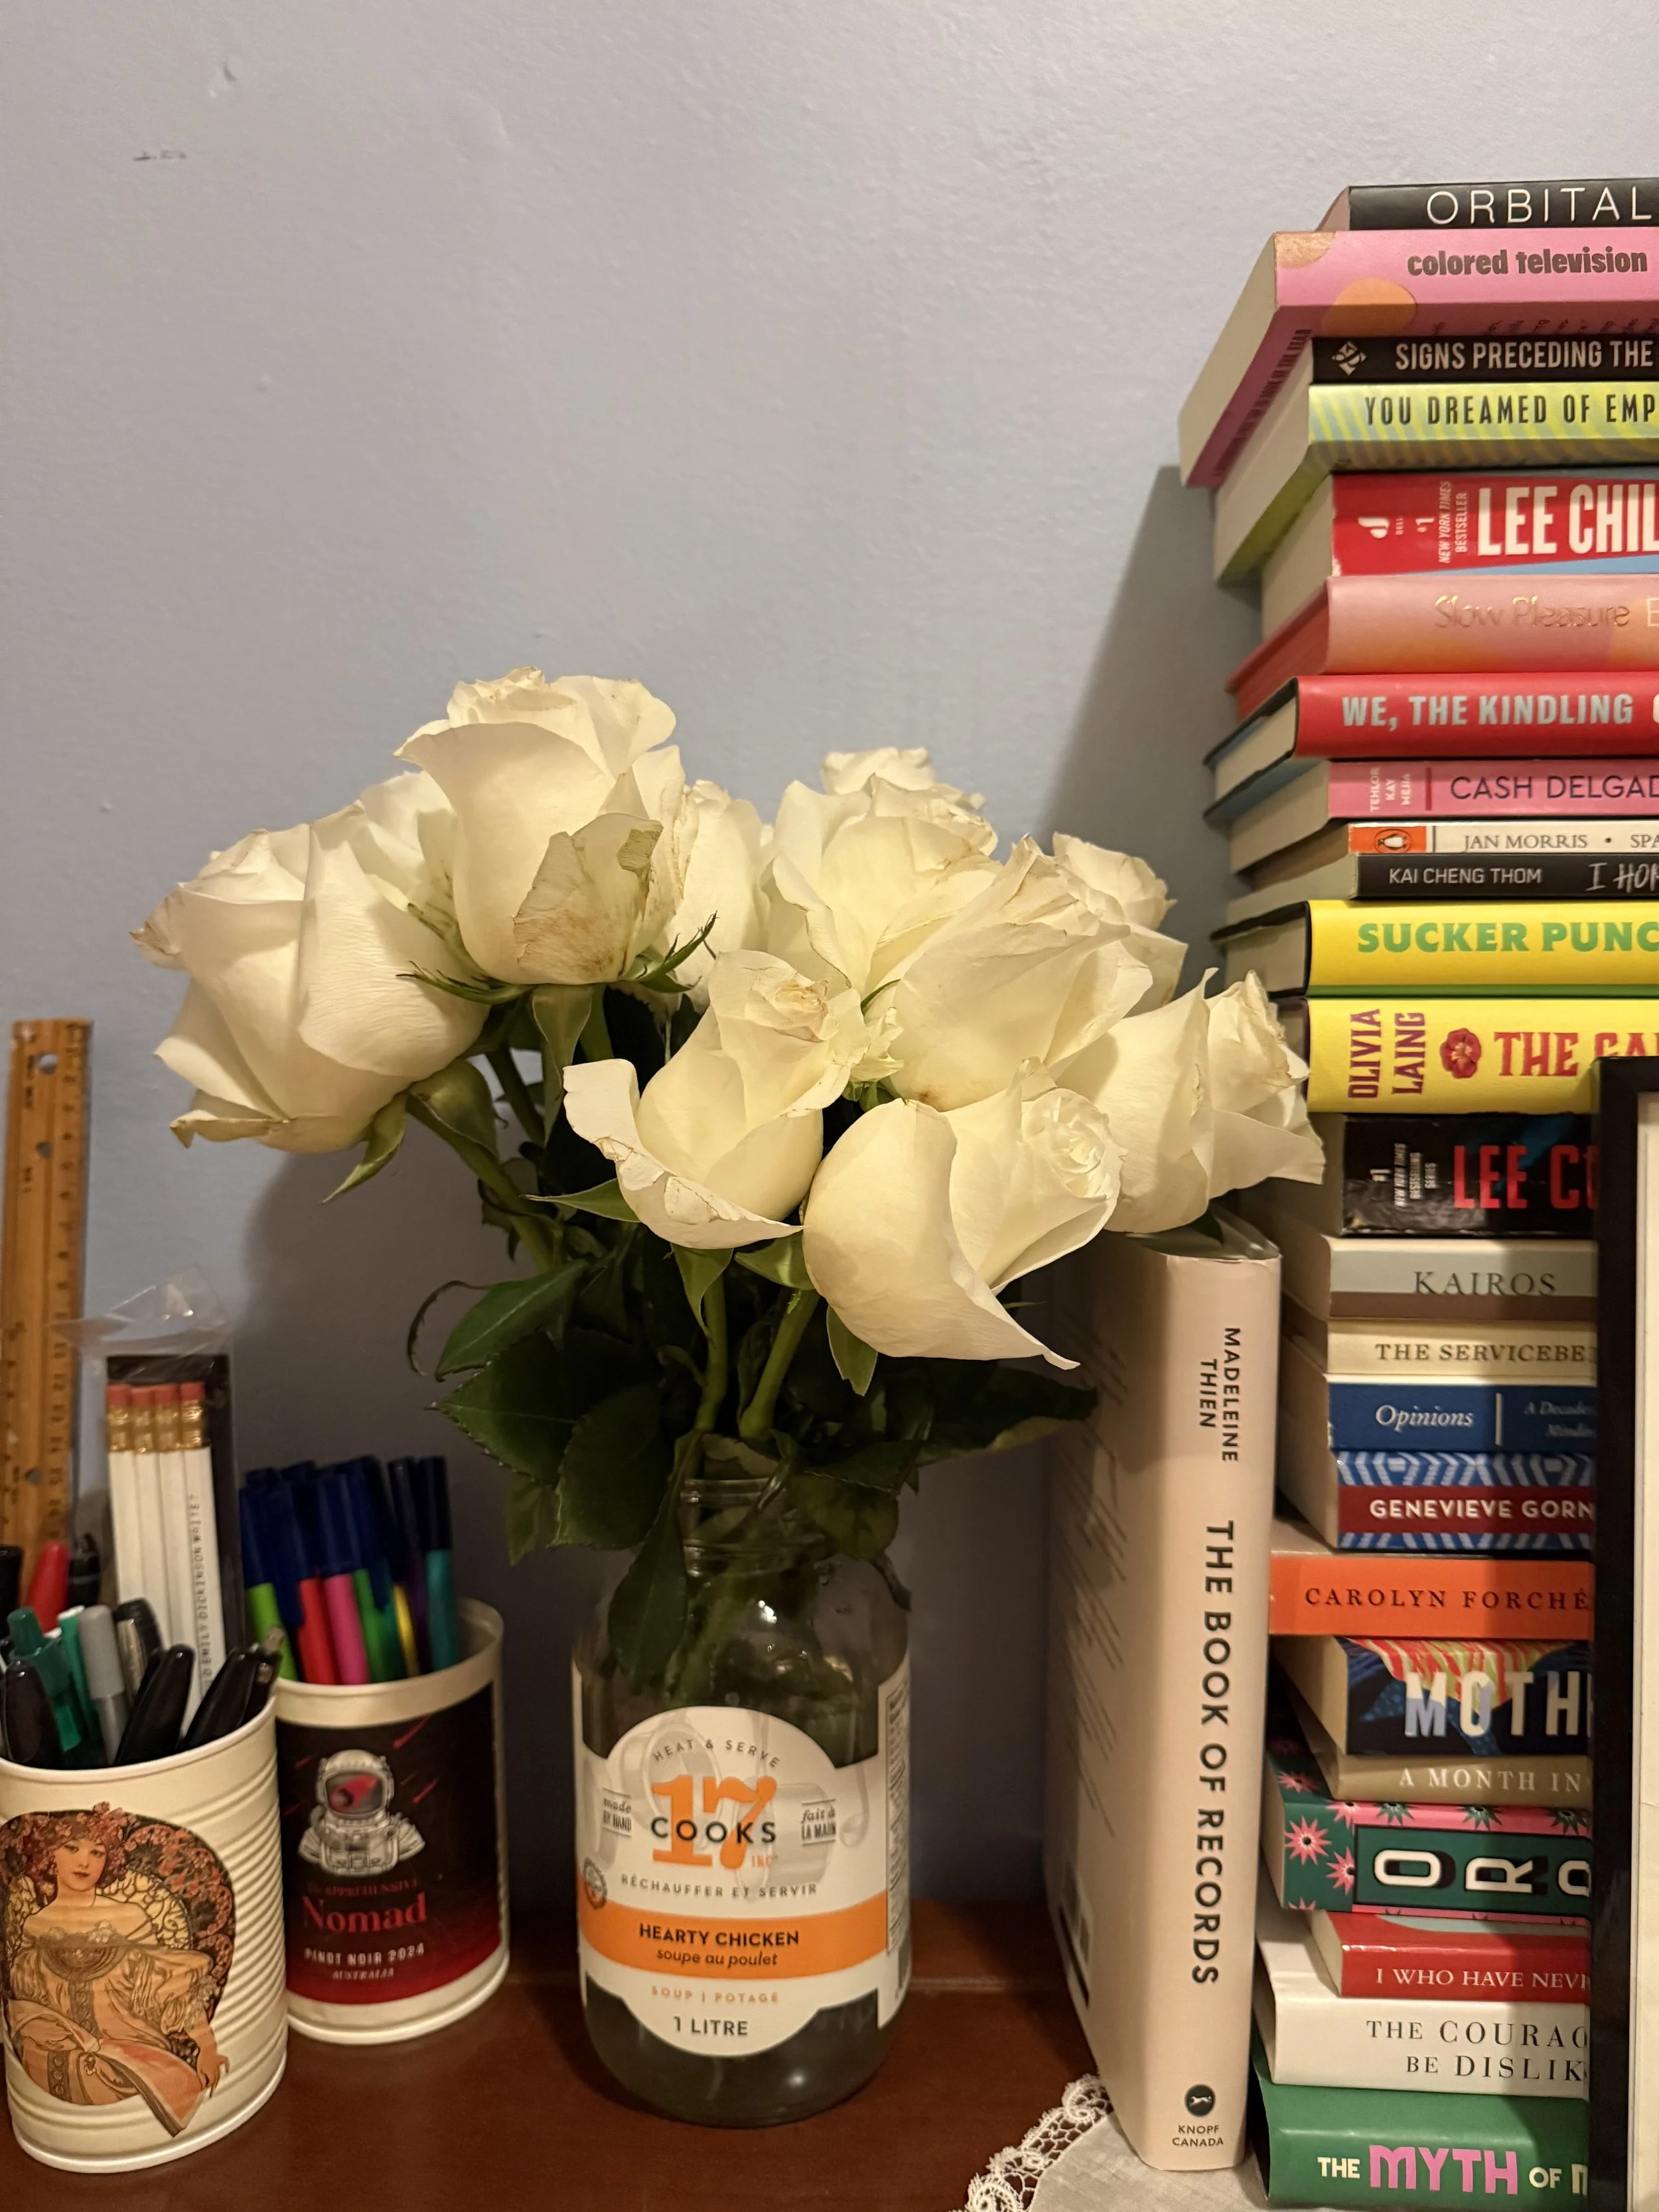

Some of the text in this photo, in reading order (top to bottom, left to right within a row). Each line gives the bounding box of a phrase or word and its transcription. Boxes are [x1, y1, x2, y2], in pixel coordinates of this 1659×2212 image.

[1426, 186, 1652, 225] ORBITAL
[1407, 246, 1648, 277] colored television
[1395, 340, 1654, 371] SIGNS PRECEDING THE
[1364, 396, 1411, 426] YOU
[1427, 394, 1547, 425] DREAMED
[1563, 394, 1591, 423] OF
[1437, 480, 1452, 564] NEW YORK TIMES
[1454, 492, 1469, 553] BESTSELLER
[1477, 485, 1558, 557] LEE
[1434, 594, 1504, 628] Slow
[1512, 594, 1630, 628] Pleasure
[1341, 696, 1398, 732] WE,
[1407, 695, 1468, 727] THE
[1478, 693, 1634, 726] KINDLING
[1384, 778, 1396, 801] KAY
[1450, 776, 1533, 800] CASH
[1463, 835, 1498, 852] JAN
[1504, 834, 1588, 849] MORRIS
[1389, 868, 1418, 885] KAI
[1423, 867, 1485, 884] CHENG
[1489, 867, 1543, 884] THOM
[1585, 862, 1609, 892] I
[1356, 921, 1659, 954] SUCKER PUNC
[1348, 1008, 1382, 1099] OLIVIA
[1391, 1011, 1426, 1095] LAING
[1493, 1031, 1579, 1078] THE
[1453, 1145, 1528, 1209] LEE
[1413, 1271, 1557, 1297] KAIROS
[1374, 1343, 1595, 1363] THE SERVICEBE
[1198, 1358, 1218, 1429] THIEN
[1221, 1327, 1242, 1462] MADELEINE
[1375, 1404, 1475, 1433] Opinions
[1369, 1499, 1514, 1520] GENEVIEVE
[194, 1546, 209, 1620] DICKINSON
[1304, 1587, 1447, 1608] CAROLYN
[199, 1625, 212, 1664] EMILY
[1404, 1670, 1593, 1738] MOTH
[652, 1738, 781, 1769] HEAT & SERVE
[1190, 1520, 1235, 1985] THE BOOK OF RECORDS
[1398, 1767, 1581, 1794] A MONTH IN
[603, 1797, 632, 1814] made
[801, 1807, 826, 1824] fait
[650, 1816, 777, 1845] COOKS
[651, 1774, 778, 1872] 17
[801, 1822, 837, 1840] LA MAIN
[620, 1873, 818, 1899] RÉCHAUFFER ET SERVIR
[302, 1891, 427, 1934] Nomad
[638, 1922, 800, 1947] HEARTY CHICKEN
[304, 1947, 342, 1966] PINOT
[346, 1951, 383, 1967] NOIR
[656, 1948, 778, 1970] soupe au poulet
[1376, 1968, 1382, 1984] I
[1391, 1968, 1454, 1986] WHO
[1462, 1970, 1524, 1988] HAVE
[650, 1984, 780, 2004] SOUP POTAGE
[673, 2016, 749, 2037] 1 LITRE
[1366, 2020, 1423, 2040] THE
[1406, 2055, 1586, 2081] BE DISLIK
[1171, 2136, 1224, 2148] CANADA
[1177, 2124, 1220, 2136] KNOPF
[1317, 2156, 1360, 2179] THE
[1368, 2144, 1518, 2195] MYTH
[1528, 2166, 1562, 2189] OF
